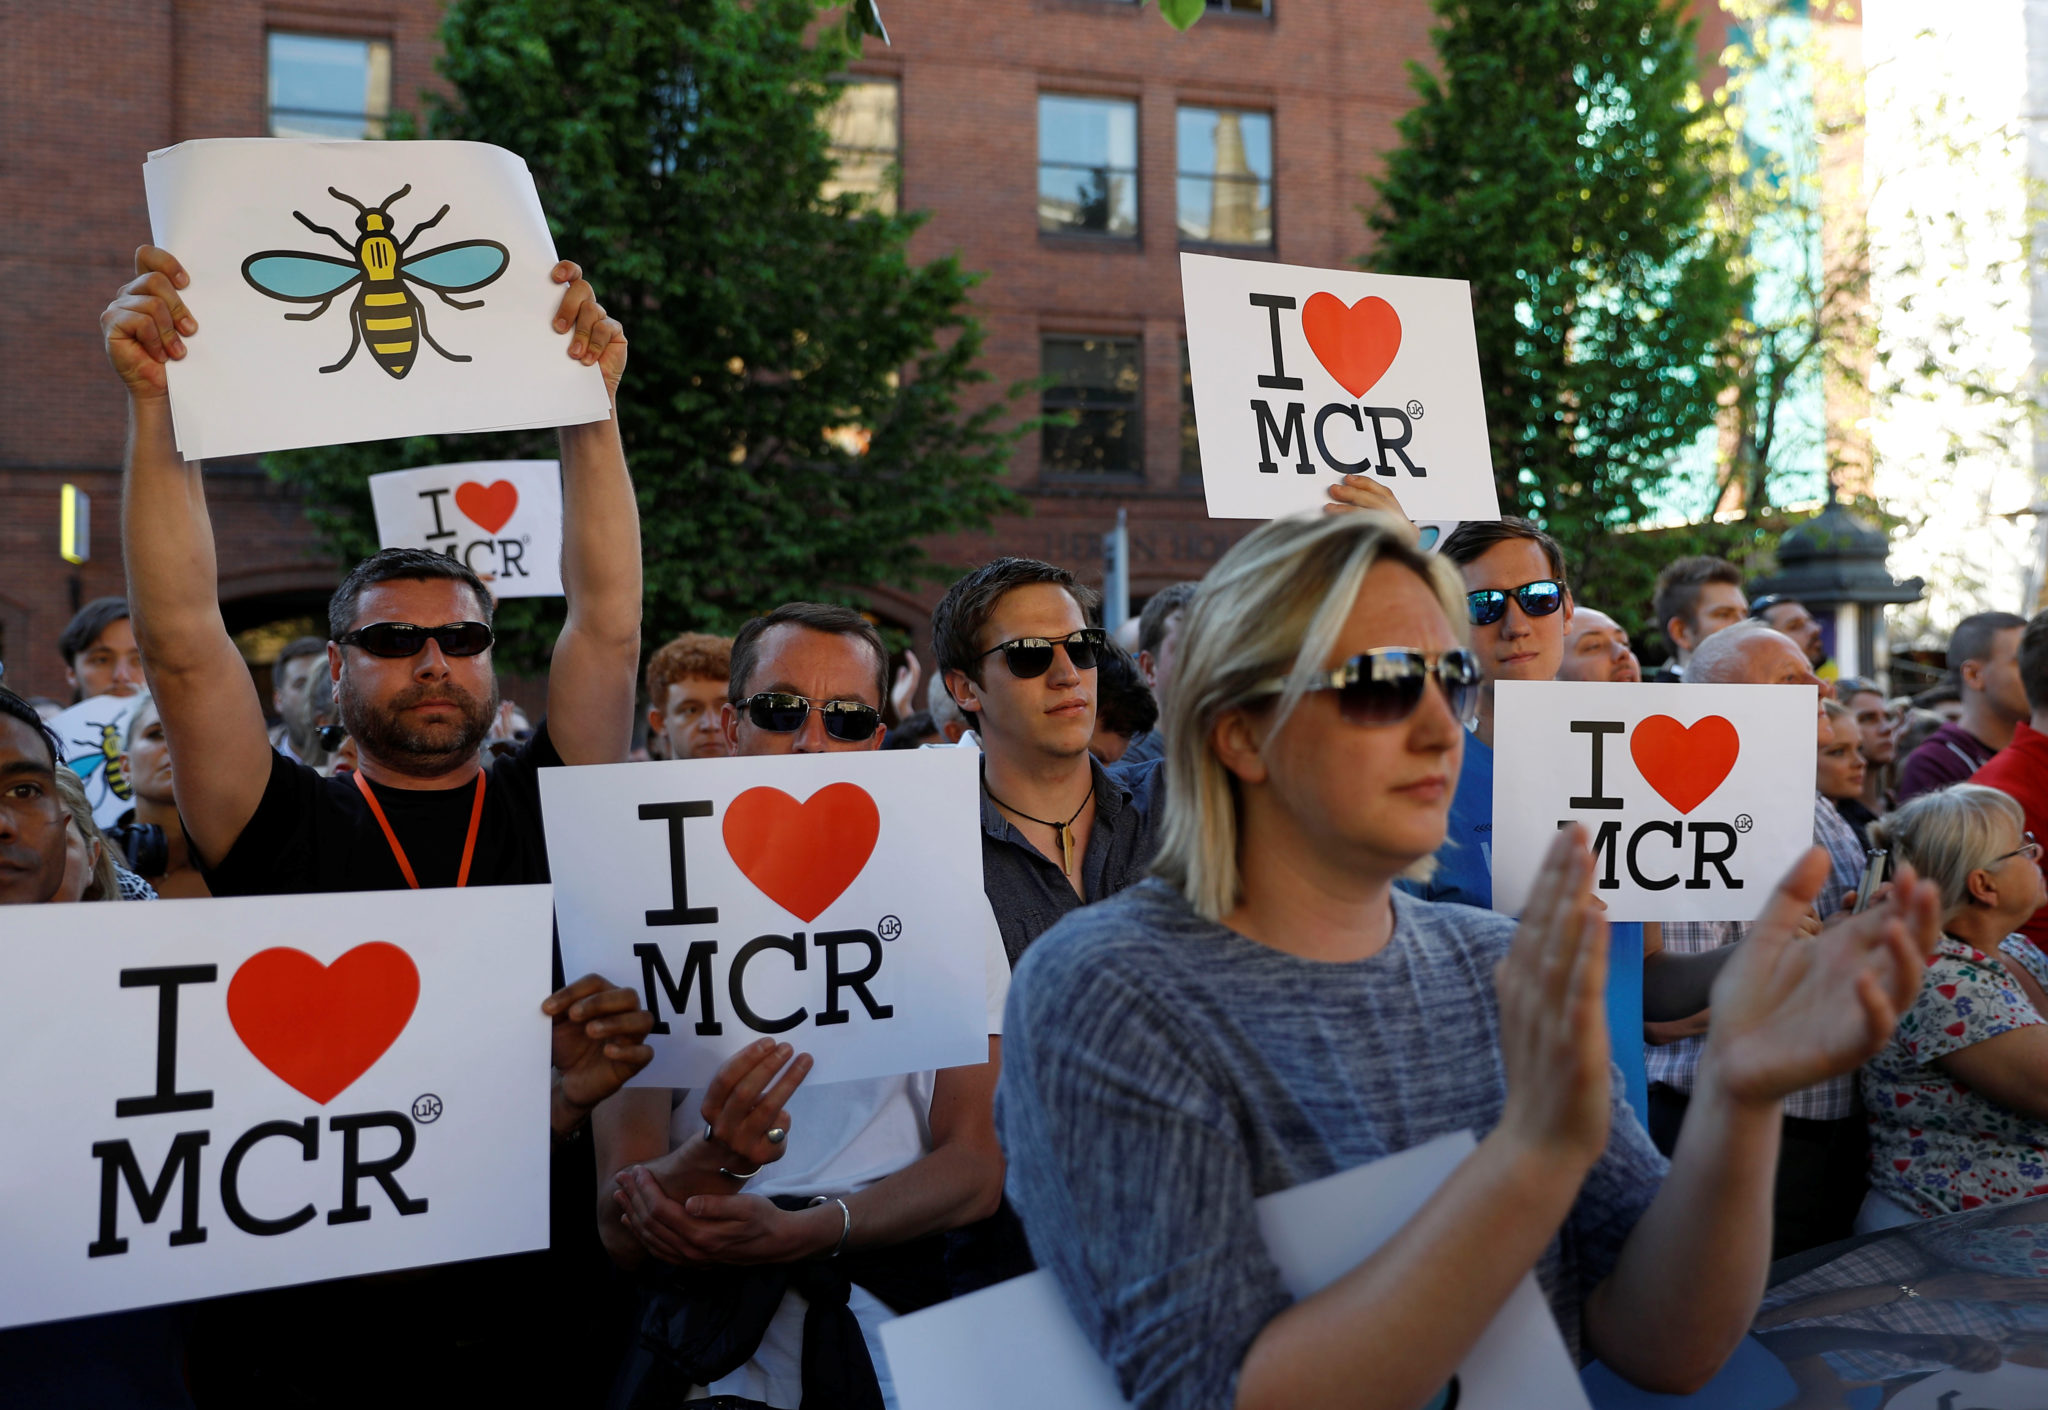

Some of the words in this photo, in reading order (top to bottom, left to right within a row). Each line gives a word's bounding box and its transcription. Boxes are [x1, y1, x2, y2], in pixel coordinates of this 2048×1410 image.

[1249, 292, 1304, 391] I
[1250, 399, 1427, 478] MCR
[418, 488, 456, 541] I
[1570, 720, 1625, 810] I
[637, 800, 719, 927] I
[633, 928, 894, 1036] MCR
[115, 964, 218, 1118] I
[88, 1110, 429, 1259] MCR
